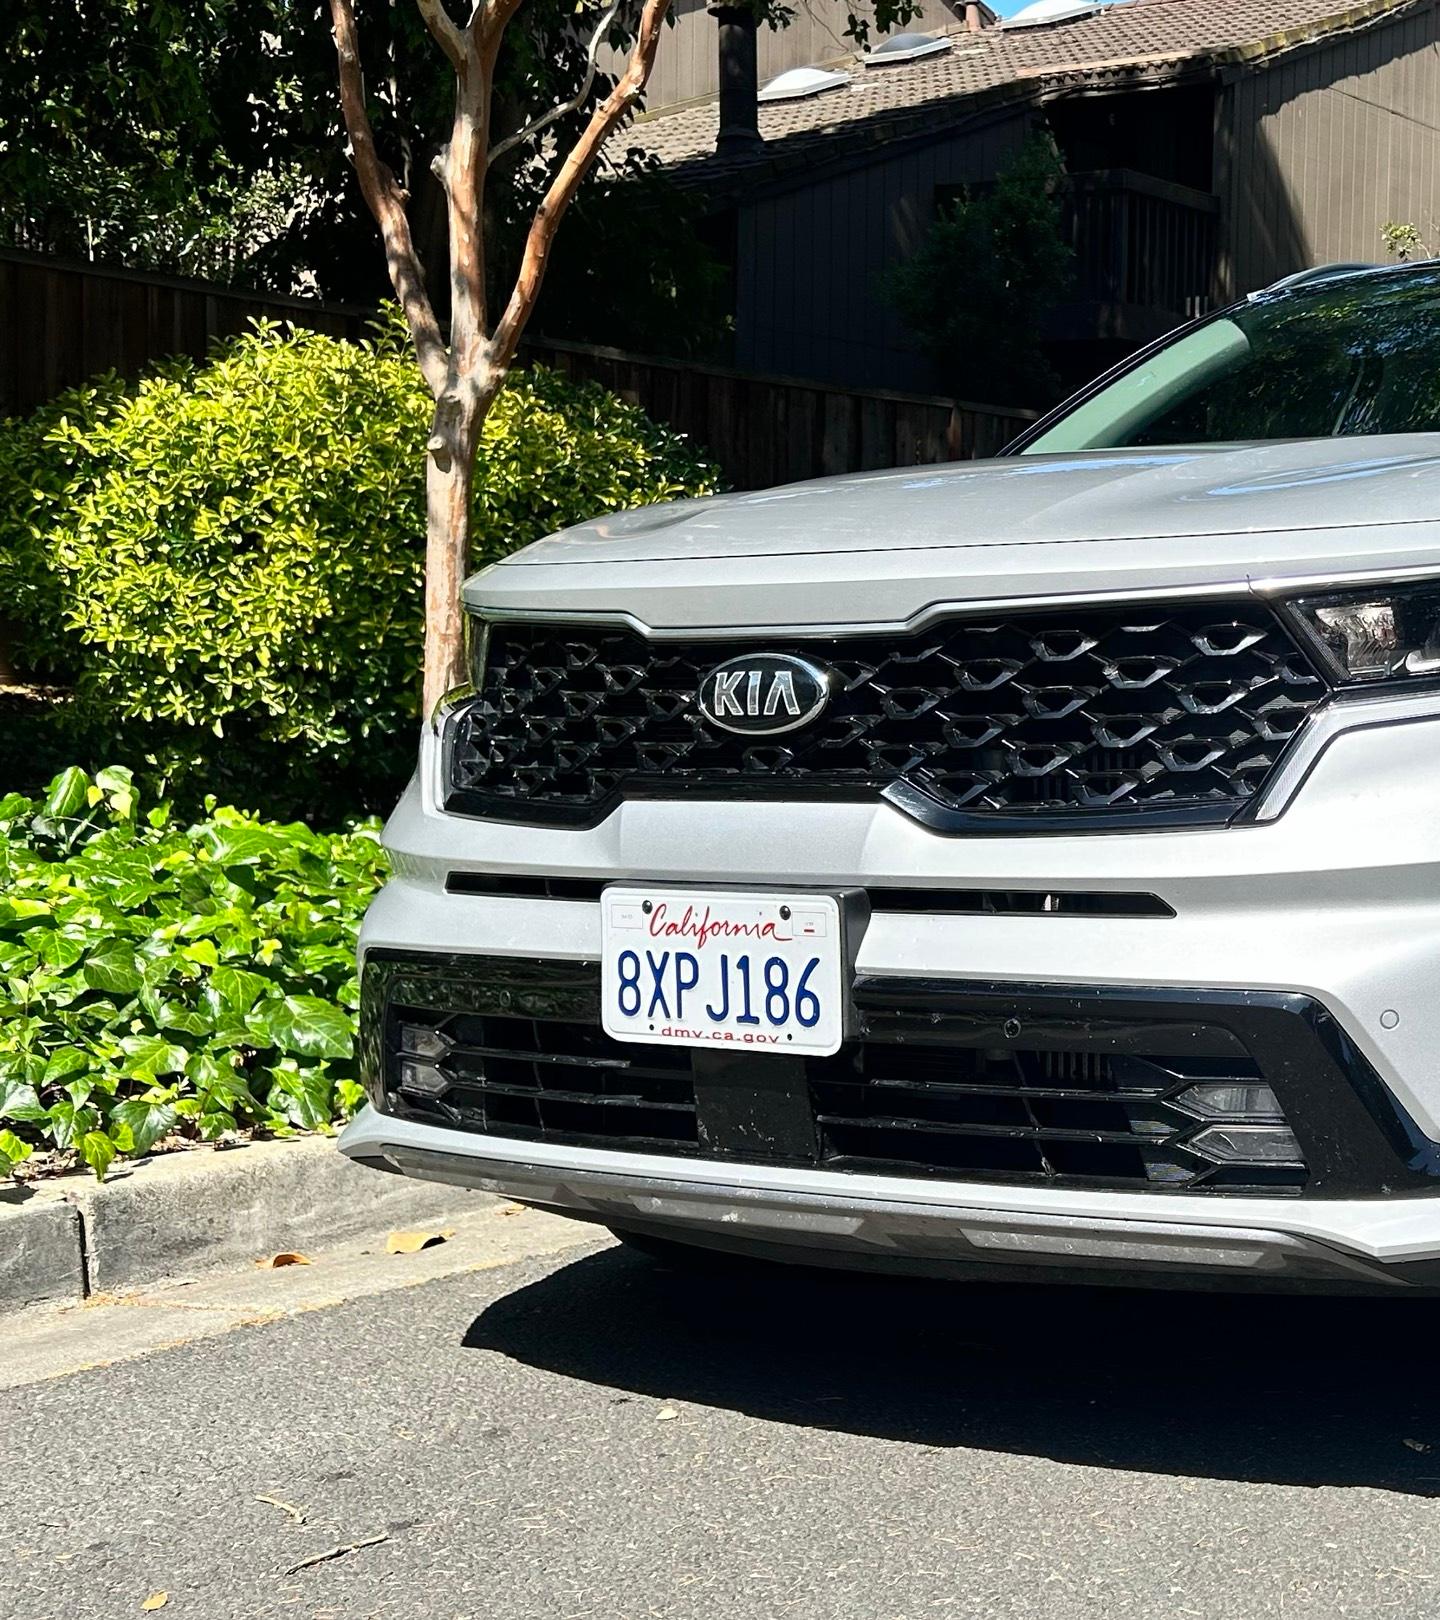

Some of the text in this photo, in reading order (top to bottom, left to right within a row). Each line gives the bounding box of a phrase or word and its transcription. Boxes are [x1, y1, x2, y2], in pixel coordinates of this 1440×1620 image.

[714, 670, 801, 716] KIA
[649, 903, 792, 950] California
[617, 949, 820, 1028] 8XPJ186
[661, 1026, 779, 1043] dmv.ca.gov
